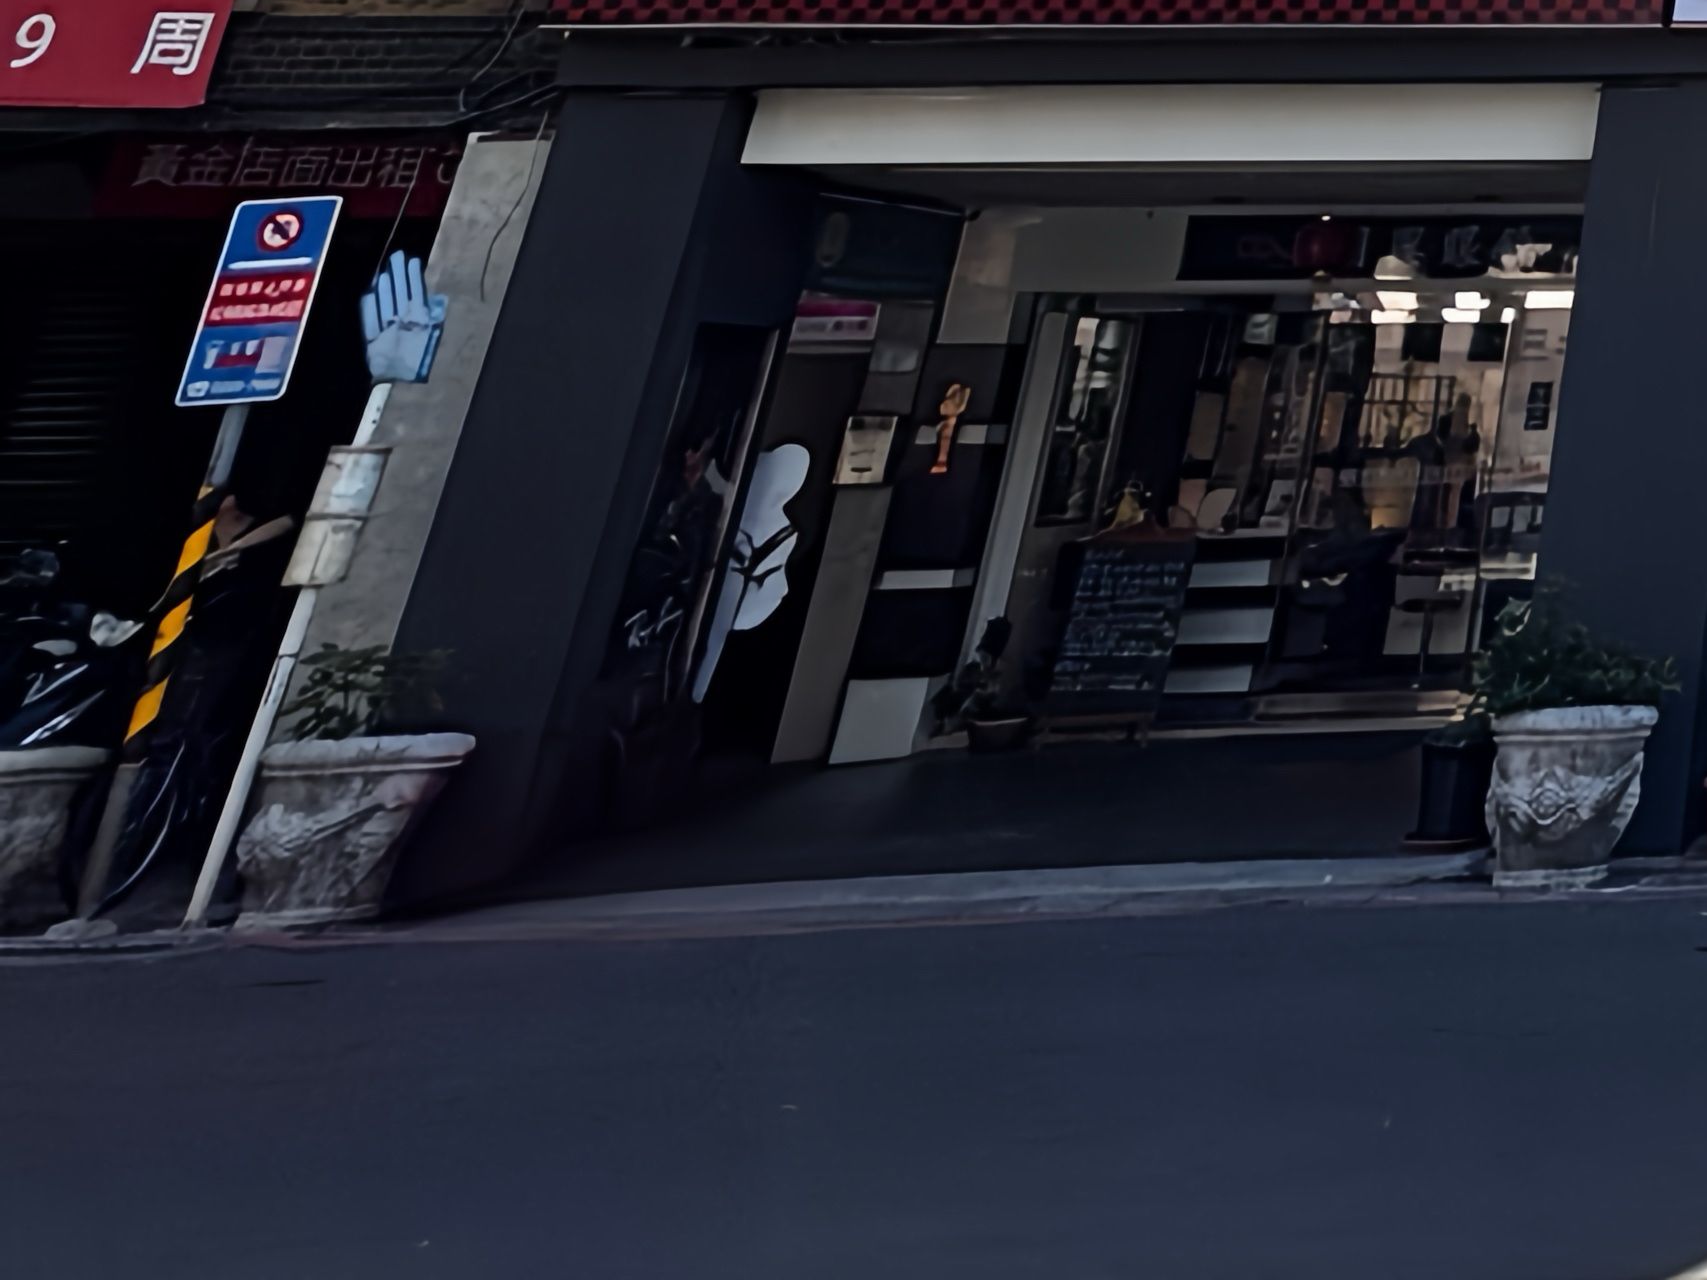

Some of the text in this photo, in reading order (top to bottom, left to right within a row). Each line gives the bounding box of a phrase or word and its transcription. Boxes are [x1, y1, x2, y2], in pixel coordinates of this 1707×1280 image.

[9, 11, 216, 76] 9 周
[131, 138, 426, 189] 黃金店面出租
